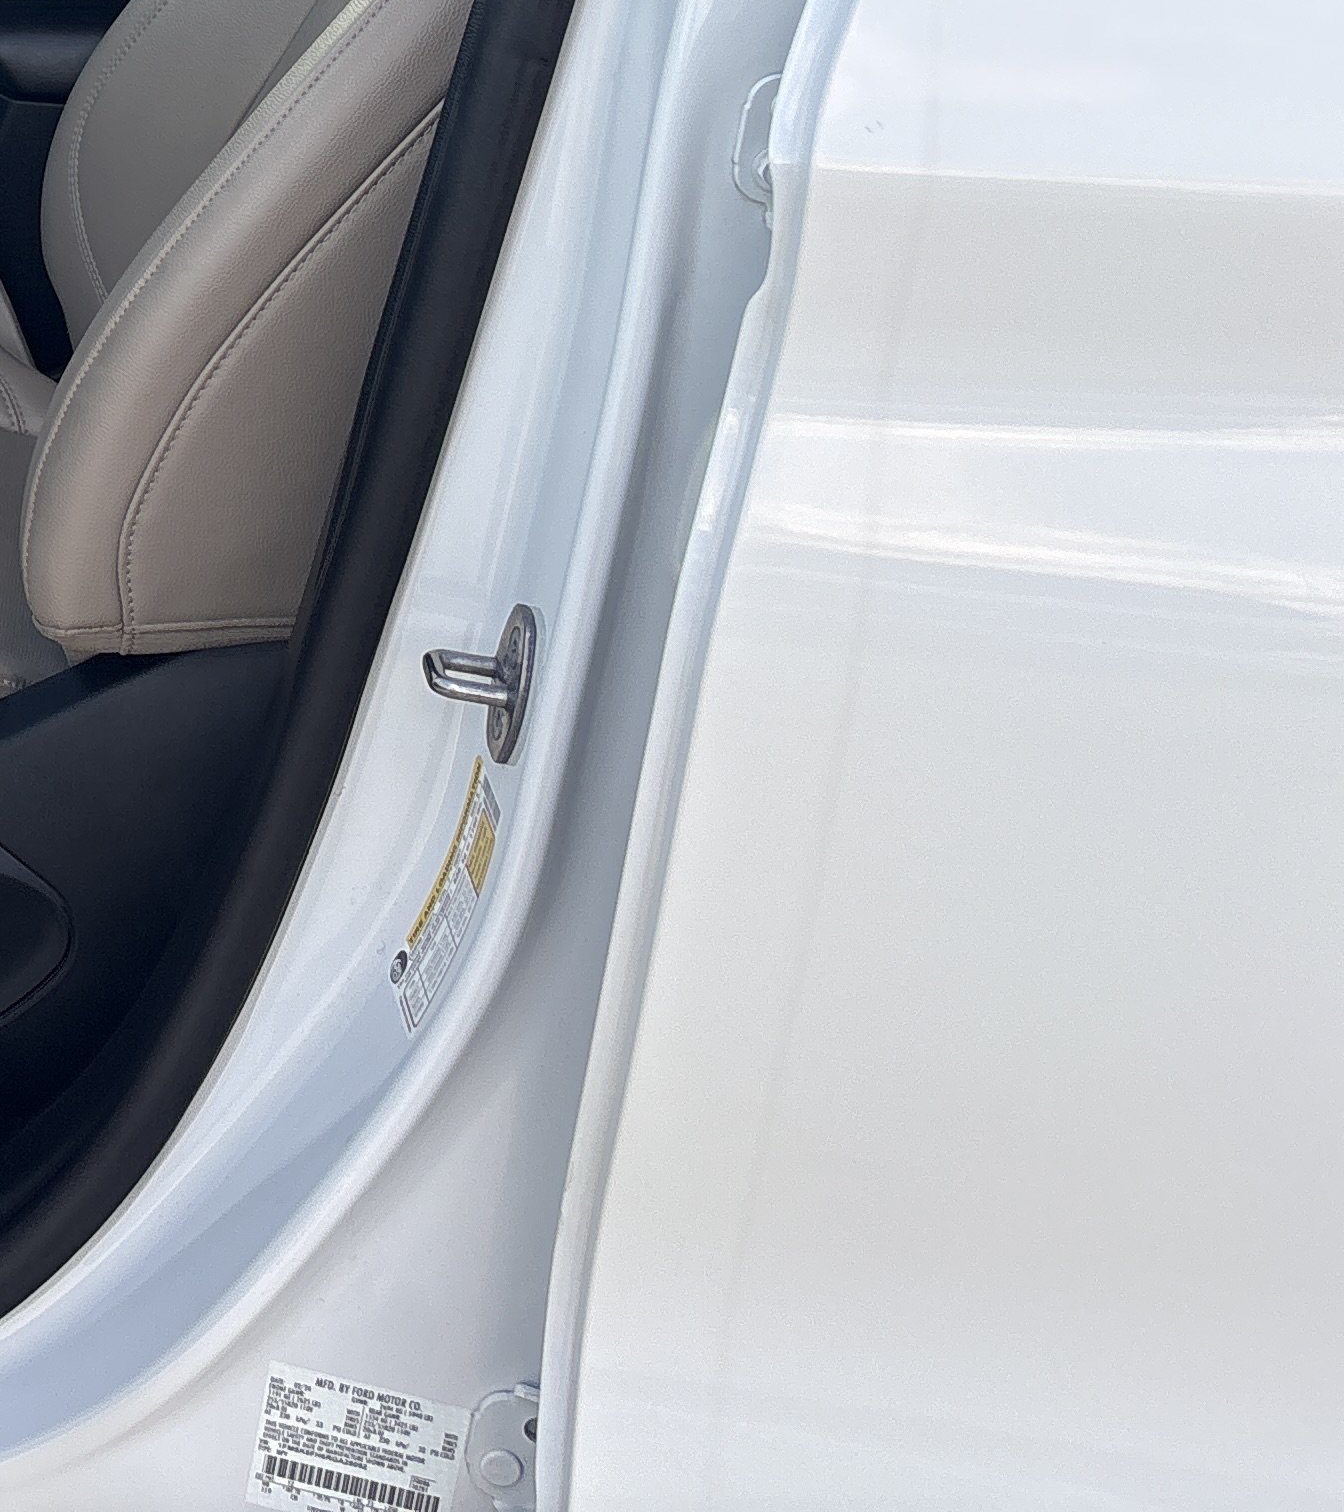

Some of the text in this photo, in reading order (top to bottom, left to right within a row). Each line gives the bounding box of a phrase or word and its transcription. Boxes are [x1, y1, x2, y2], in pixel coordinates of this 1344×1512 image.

[339, 1383, 351, 1395] BY
[352, 1386, 374, 1400] FORD
[376, 1392, 407, 1407] MOTOR
